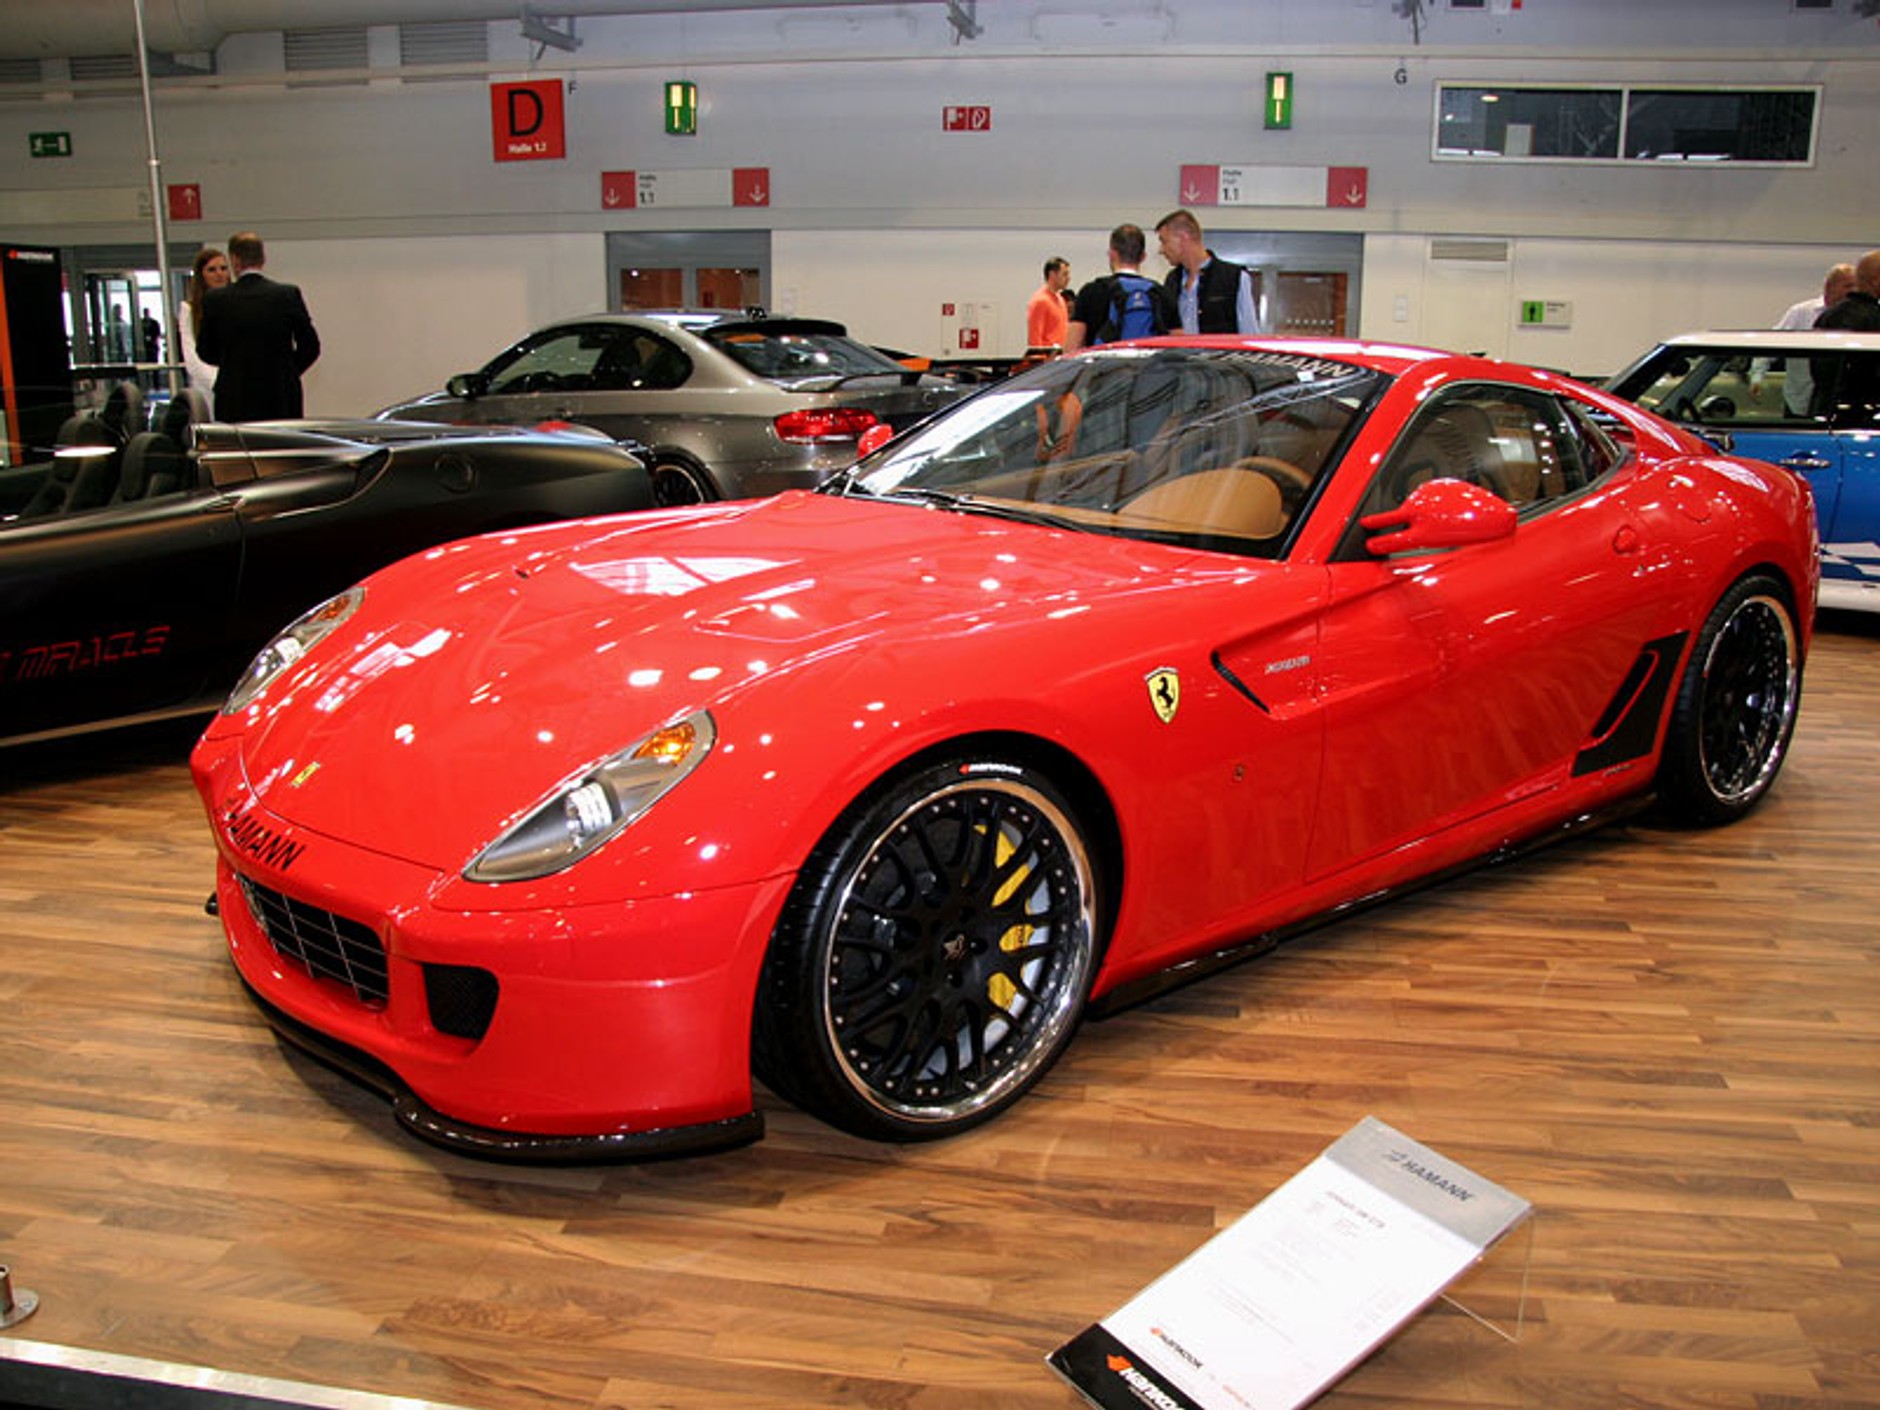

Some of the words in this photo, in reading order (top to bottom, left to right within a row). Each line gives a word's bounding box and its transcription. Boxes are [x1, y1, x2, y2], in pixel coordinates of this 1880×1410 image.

[1393, 68, 1408, 86] G
[507, 89, 544, 137] D
[1400, 1159, 1477, 1203] HAMANN
